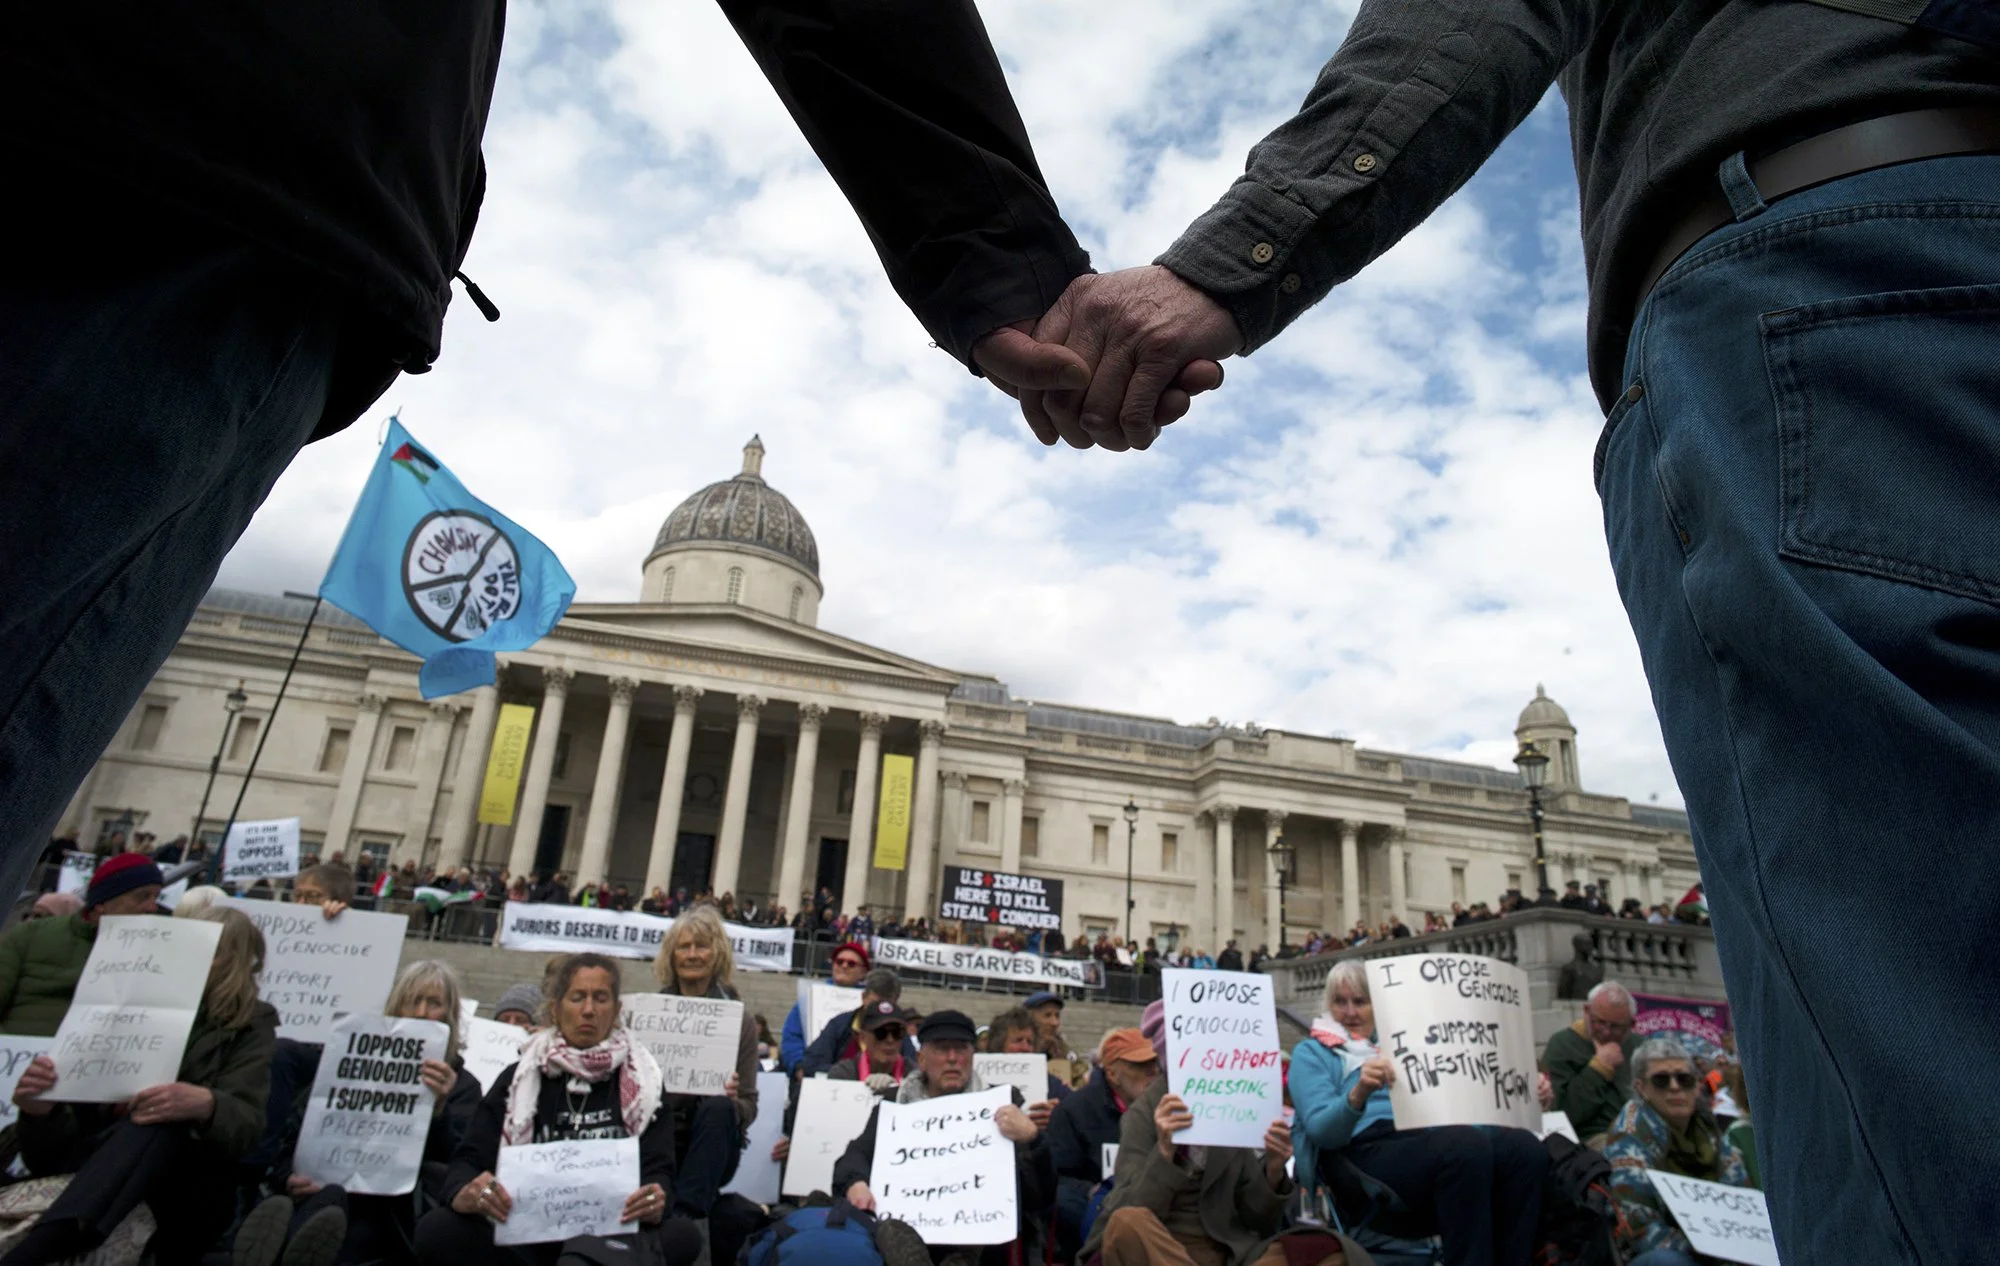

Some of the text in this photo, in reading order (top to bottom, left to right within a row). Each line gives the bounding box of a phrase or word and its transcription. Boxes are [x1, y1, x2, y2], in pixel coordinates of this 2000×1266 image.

[238, 845, 284, 859] OPPOSE
[231, 861, 289, 876] GENOCIDE
[993, 873, 1047, 894] ISRAEL
[955, 886, 1050, 911] HERE TO KILL
[942, 902, 1060, 930] STEAL CONQUER
[276, 938, 373, 957] GENOCIDE
[511, 917, 561, 936] JURORS
[564, 921, 618, 940] DESERVE
[624, 926, 638, 942] TO
[641, 928, 665, 944] HEA
[750, 940, 786, 957] TRUTH
[878, 942, 946, 967] ISRAEL
[951, 953, 1035, 975] STARVES
[1380, 957, 1490, 988] I OPPOSE
[266, 991, 341, 1008] ESTINE
[1172, 980, 1261, 1005] I OPPOSE
[1458, 978, 1520, 1006] GENOCIDE
[676, 1000, 725, 1018] OPPOSE
[1172, 1015, 1264, 1040] GENOCIDE
[1391, 1021, 1499, 1057] I SUPPORT
[347, 1032, 426, 1060] I OPPOSE
[65, 1058, 144, 1081] ACTION
[337, 1057, 423, 1085] GENOCIDE
[1179, 1047, 1280, 1071] I SUPPORT
[1183, 1077, 1270, 1098] PALESTINE
[326, 1086, 420, 1115] I SUPPORT
[1191, 1103, 1259, 1122] ACTION
[320, 1114, 413, 1137] PALESTINE
[912, 1107, 992, 1132] oppose
[327, 1144, 391, 1165] ACTION
[890, 1133, 992, 1166] genocide
[884, 1173, 986, 1201] I support
[1681, 1182, 1764, 1216] OPPOSE
